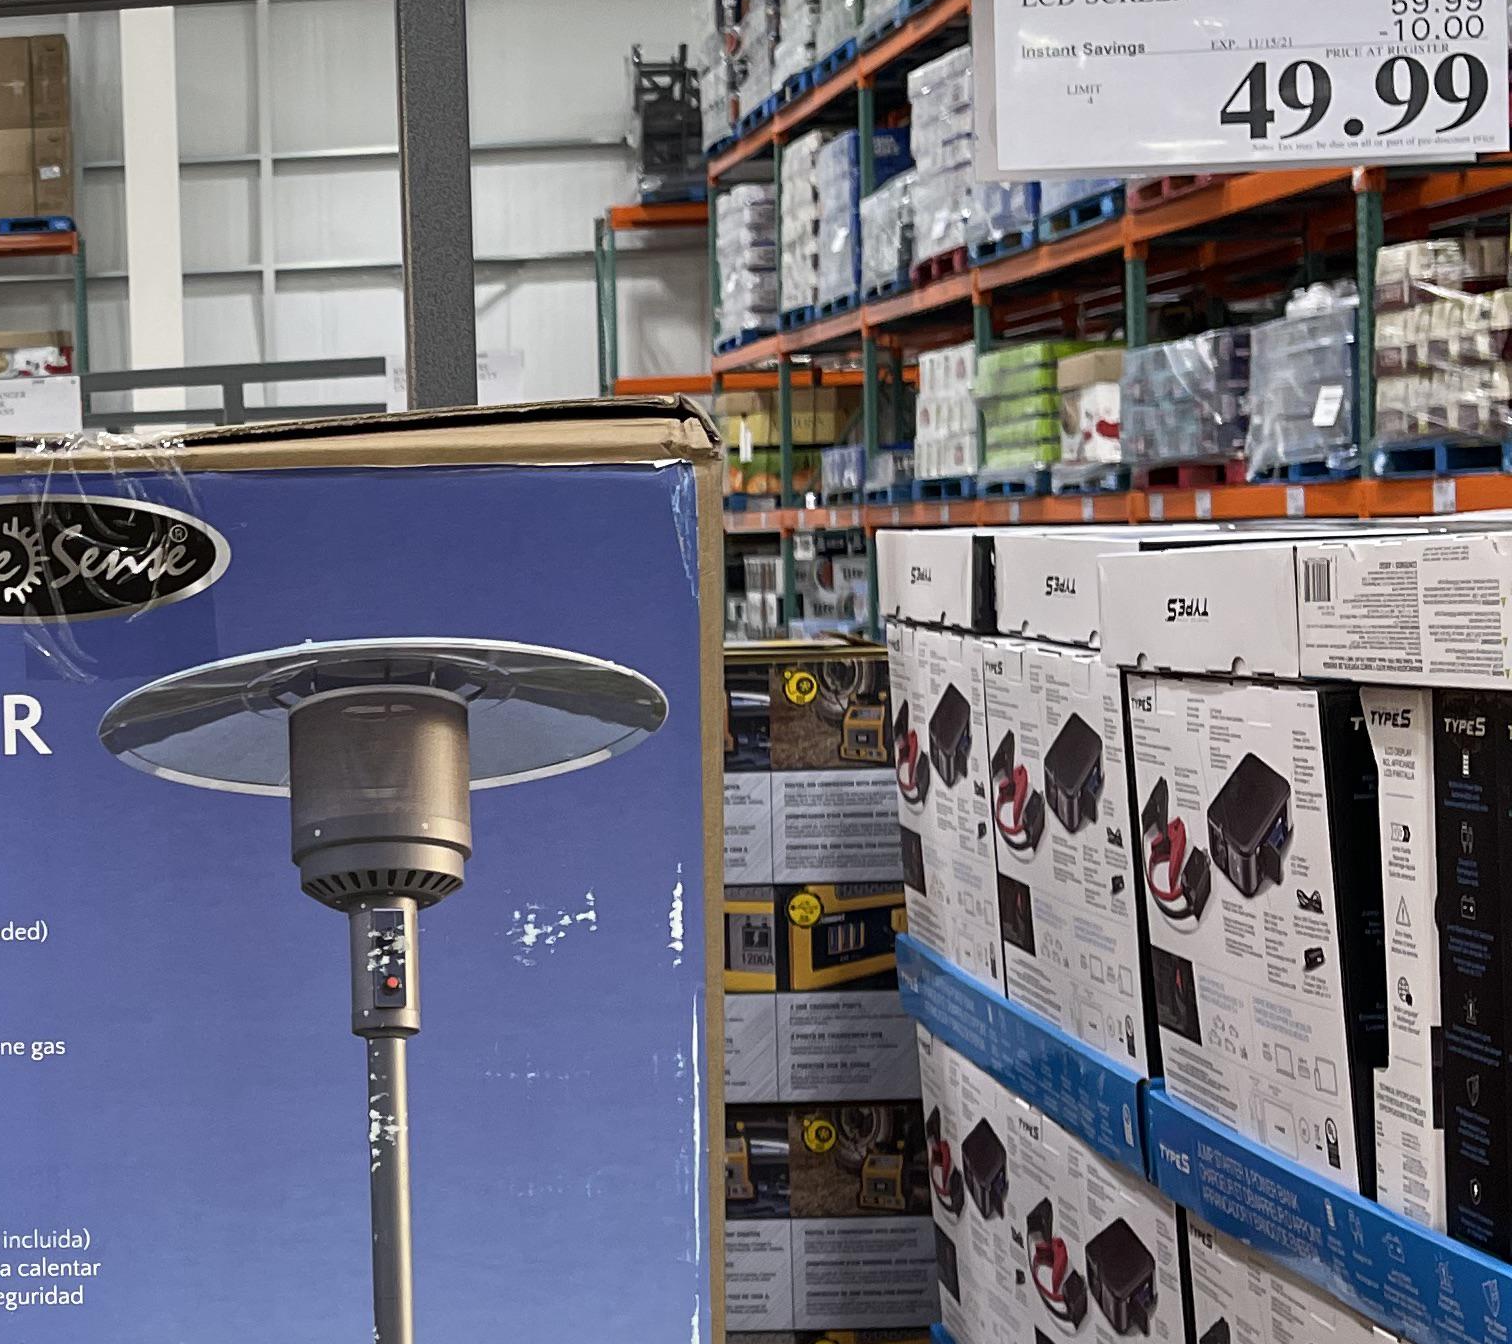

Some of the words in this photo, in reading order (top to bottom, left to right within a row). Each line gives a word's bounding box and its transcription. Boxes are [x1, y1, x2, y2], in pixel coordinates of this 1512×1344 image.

[1379, 15, 1485, 43] -10.00
[1021, 44, 1078, 59] Instant
[1082, 40, 1146, 60] Savings
[1325, 46, 1363, 59] PRICE
[1366, 45, 1384, 57] AT
[1387, 42, 1451, 56] REGISTER
[1066, 83, 1103, 96] LIMIT
[1220, 52, 1489, 140] 49.99
[50, 524, 197, 590] Sense
